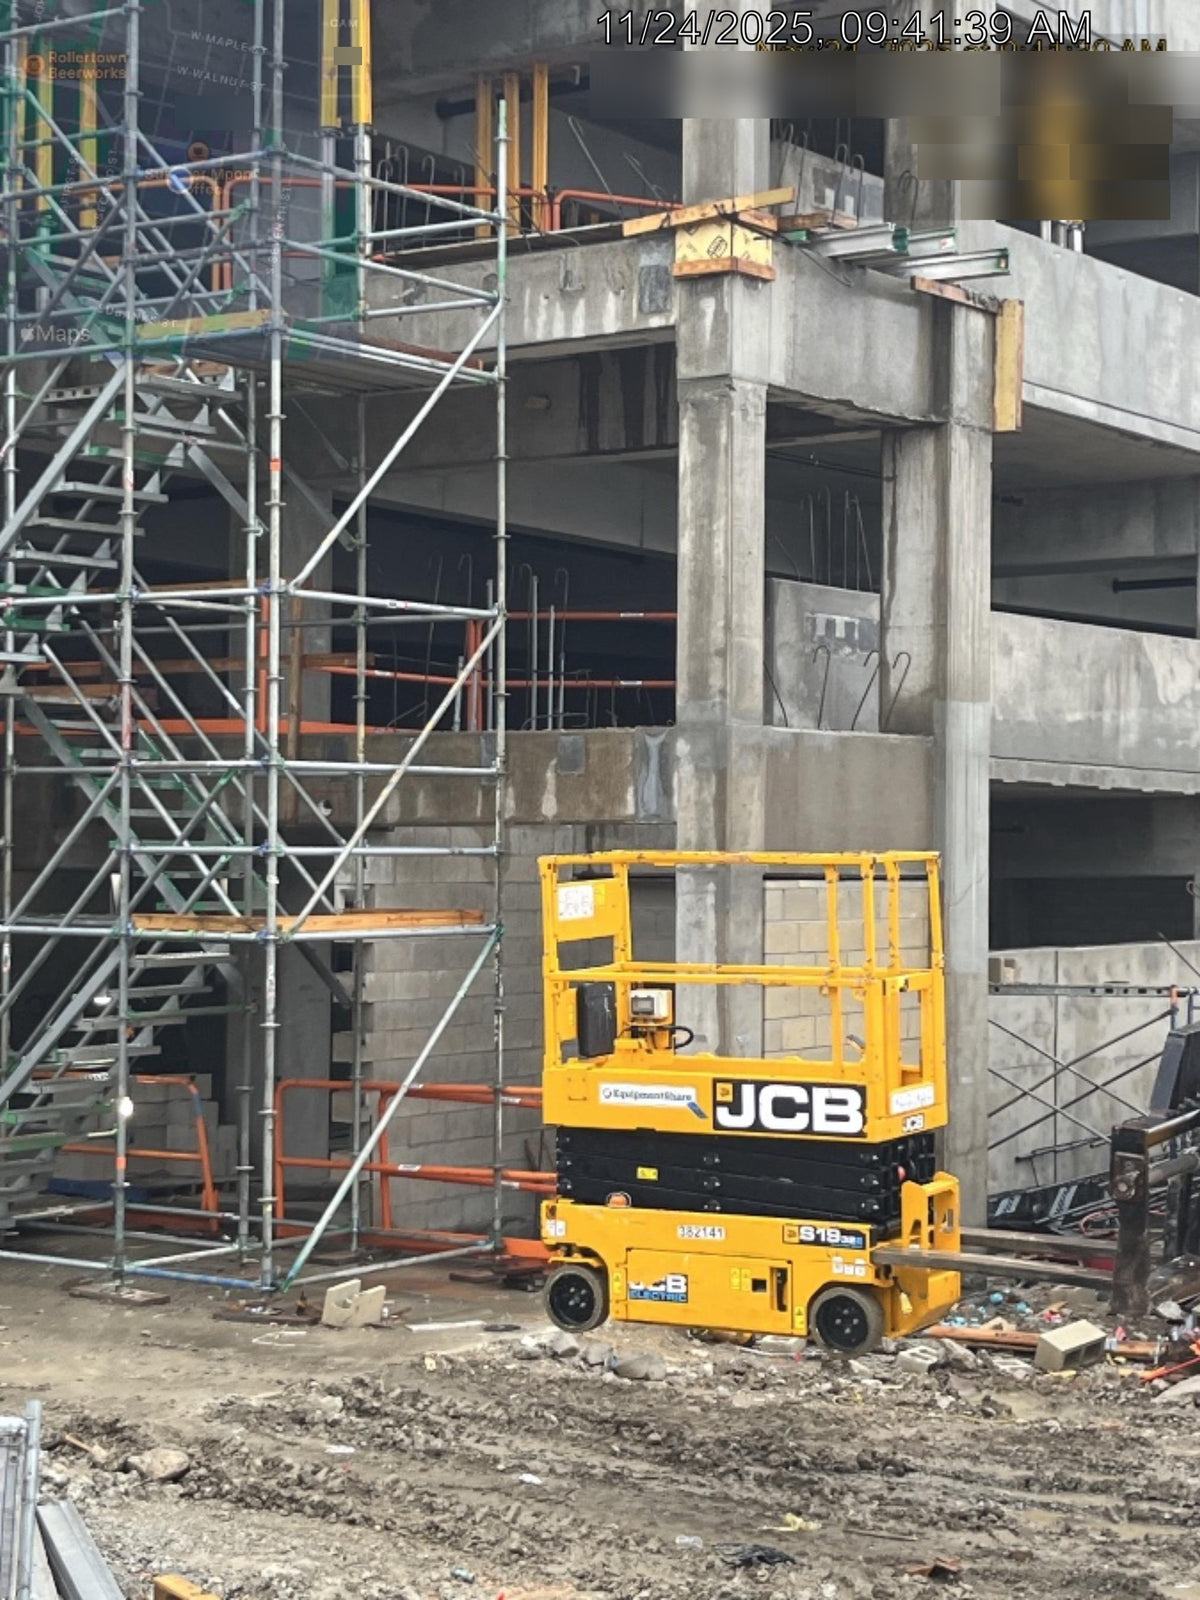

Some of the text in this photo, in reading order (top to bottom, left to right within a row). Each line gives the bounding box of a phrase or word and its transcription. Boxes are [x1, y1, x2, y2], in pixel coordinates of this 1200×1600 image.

[613, 1089, 692, 1101] EquipmentShare
[716, 1084, 863, 1134] JCB
[679, 1225, 723, 1239] 382141
